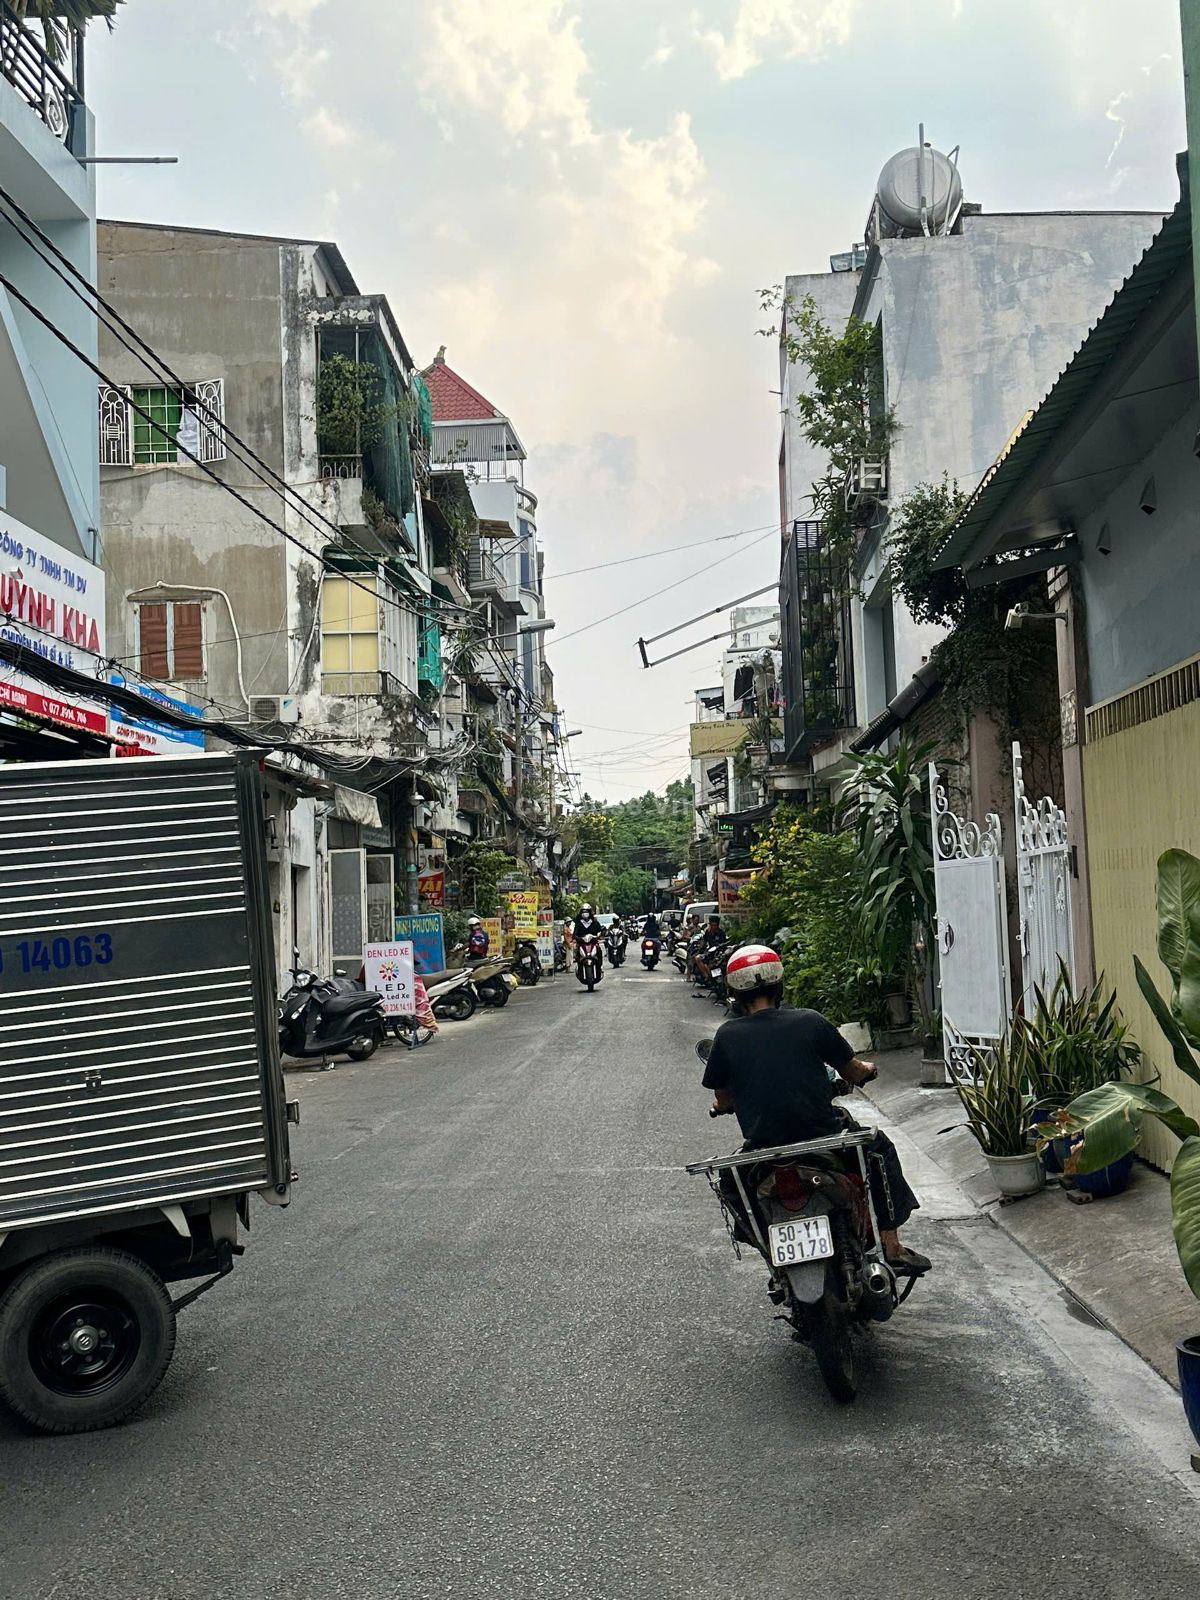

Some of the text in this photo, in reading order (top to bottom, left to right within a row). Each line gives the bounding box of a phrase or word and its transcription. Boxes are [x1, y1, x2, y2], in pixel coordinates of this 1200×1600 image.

[26, 547, 37, 568] TY
[40, 555, 61, 581] TNHH
[63, 568, 75, 588] TM
[76, 576, 87, 594] DV
[63, 603, 100, 653] KHA
[16, 933, 113, 973] 14063
[384, 948, 398, 957] LED
[400, 947, 409, 955] XE
[778, 1220, 820, 1243] 50-Y1
[777, 1238, 828, 1262] 691.78
